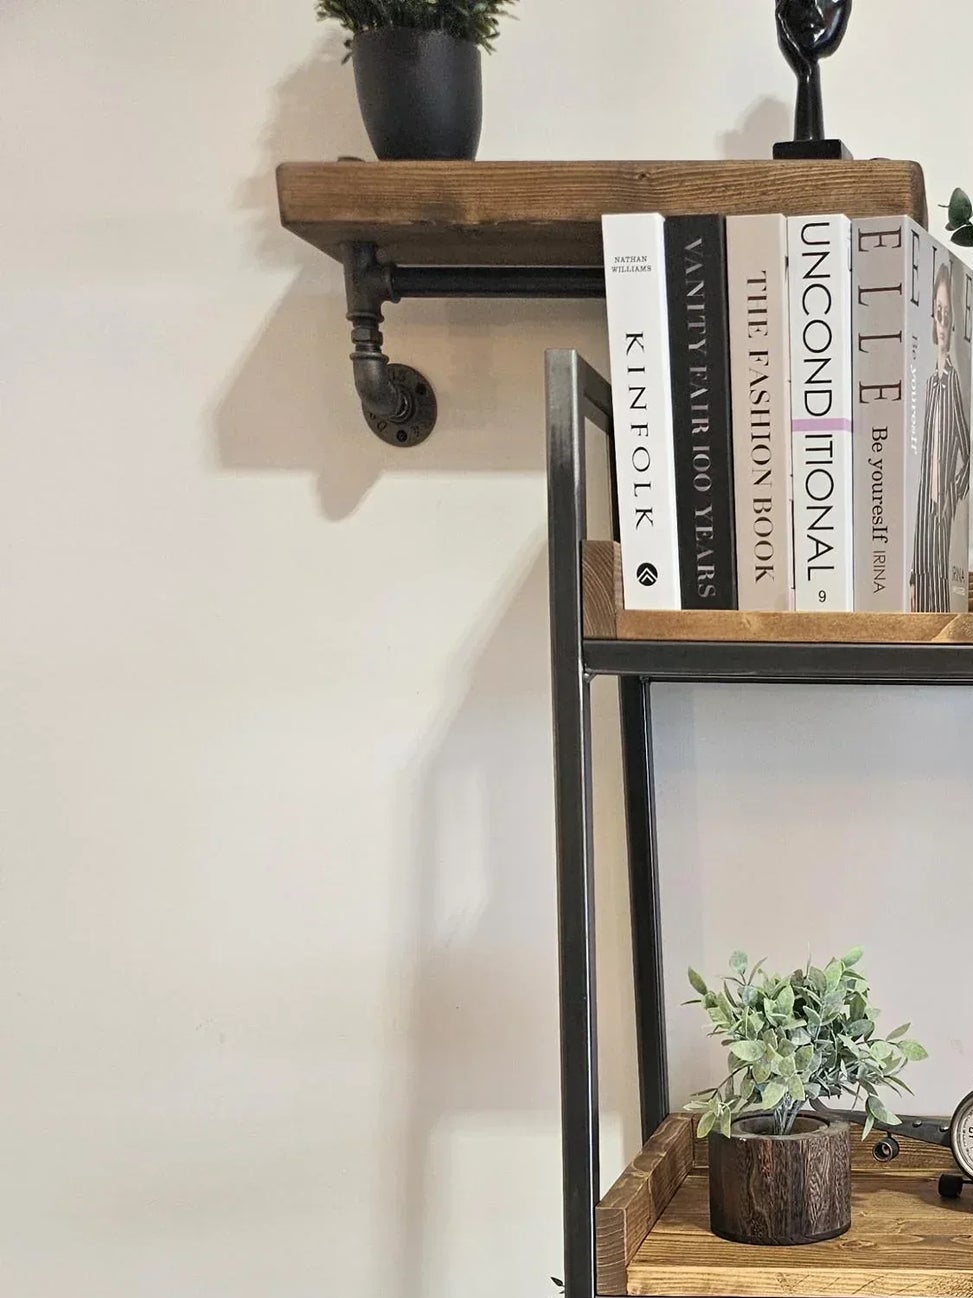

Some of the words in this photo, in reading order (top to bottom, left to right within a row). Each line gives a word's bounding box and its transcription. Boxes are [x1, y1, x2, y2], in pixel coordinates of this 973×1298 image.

[611, 265, 652, 273] WILLIAMS
[614, 255, 648, 263] NATHAN
[683, 238, 707, 355] VANITY
[746, 270, 768, 338] THE
[857, 226, 903, 404] ELLE
[625, 332, 654, 530] KINFOLK
[689, 366, 710, 434] FAIR
[748, 350, 772, 486] FASHION
[871, 426, 888, 452] Be
[694, 505, 716, 598] YEARS
[752, 498, 775, 583] BOOK
[873, 550, 887, 594] IRINA
[818, 589, 827, 603] 9
